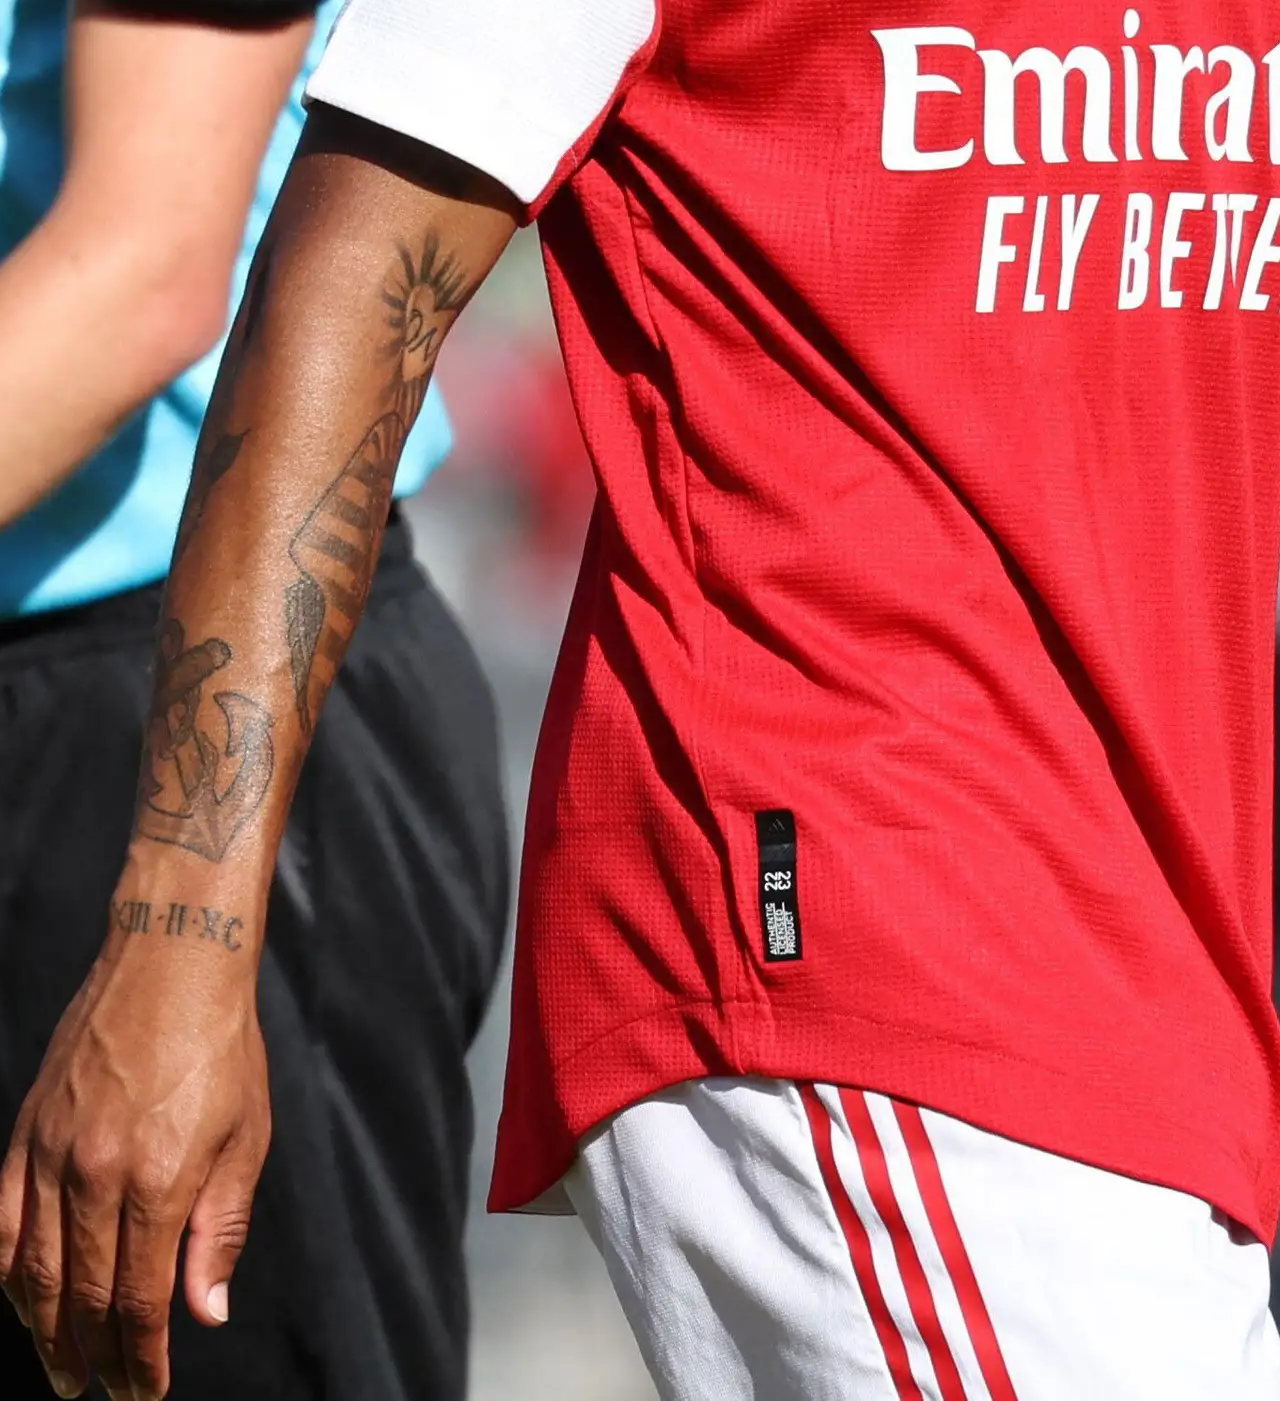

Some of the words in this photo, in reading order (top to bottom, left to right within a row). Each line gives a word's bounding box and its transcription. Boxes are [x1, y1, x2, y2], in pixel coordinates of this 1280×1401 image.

[975, 193, 1100, 314] FLY
[764, 871, 778, 891] 22
[777, 870, 791, 890] 23
[765, 902, 778, 955] AUTHENTIC
[775, 908, 786, 955] LICENSED
[785, 910, 796, 954] PRODUCT
